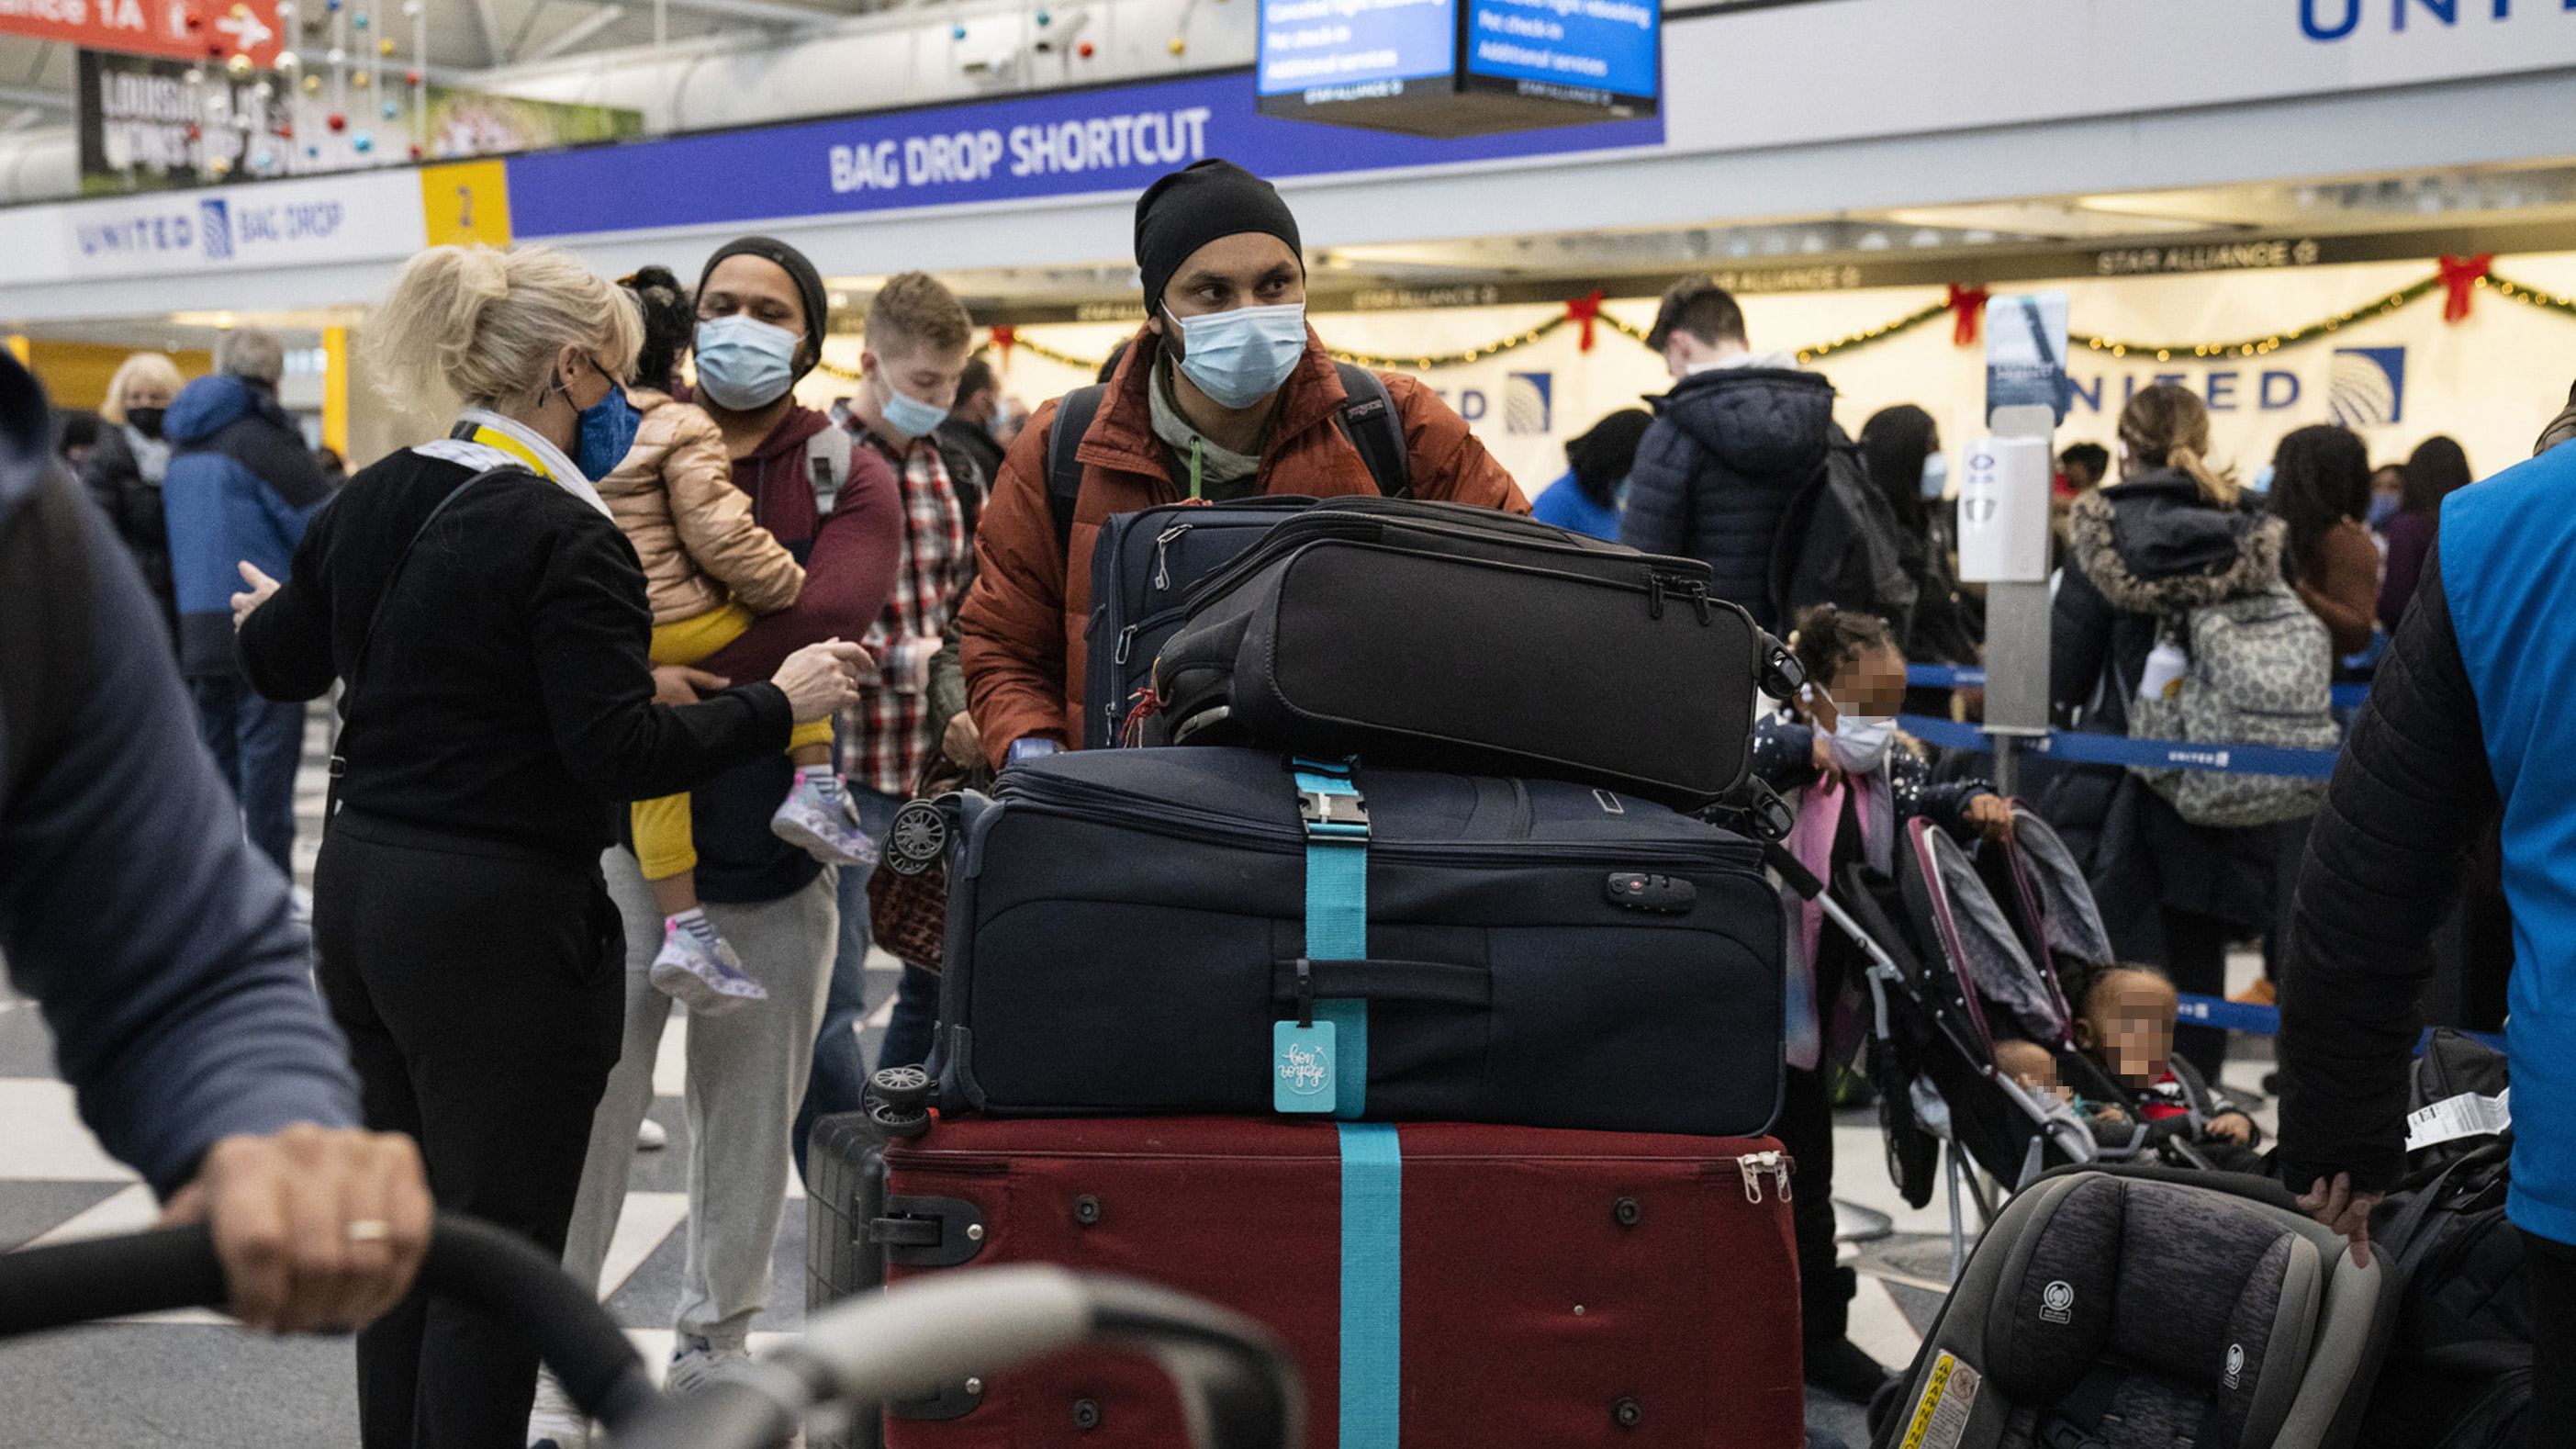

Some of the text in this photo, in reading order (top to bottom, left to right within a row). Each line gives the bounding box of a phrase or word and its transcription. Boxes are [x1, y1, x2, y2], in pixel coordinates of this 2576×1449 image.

[1505, 16, 1564, 40] check-in
[1267, 50, 1398, 79] Additional services
[1477, 40, 1607, 76] Additional services
[829, 107, 1211, 194] BAG DROP SHORTCUT
[79, 201, 345, 255] UNITED BAG DROP
[2097, 240, 2290, 275] STAR ALLIANCE
[1282, 1043, 1316, 1065] bon
[1277, 1063, 1326, 1087] voyage
